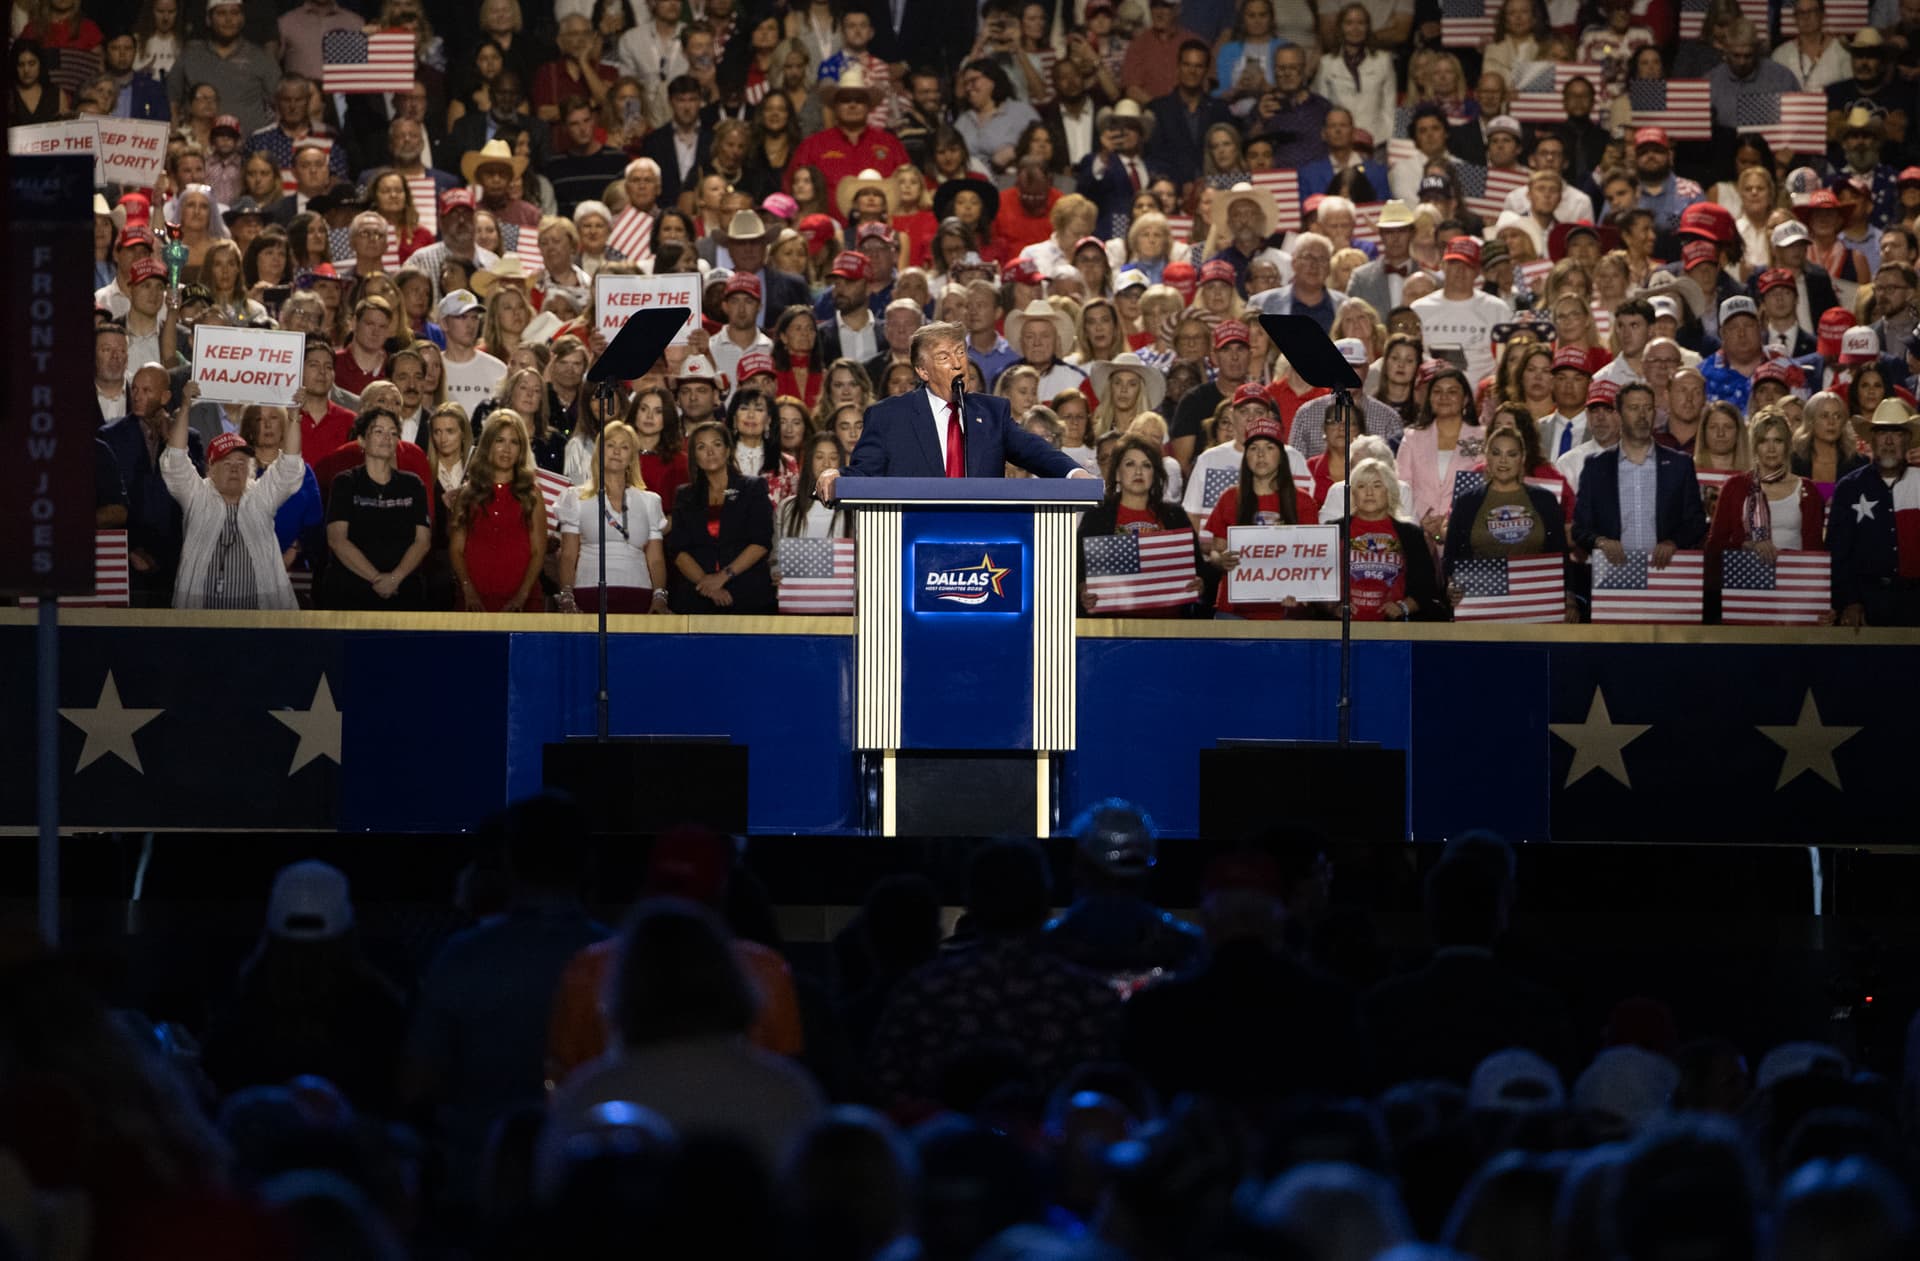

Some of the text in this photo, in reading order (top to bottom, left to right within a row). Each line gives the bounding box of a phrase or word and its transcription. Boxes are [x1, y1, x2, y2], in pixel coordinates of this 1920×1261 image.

[64, 136, 93, 150] THE
[101, 132, 159, 150] EEP THE
[104, 153, 159, 170] JORITY
[607, 291, 690, 306] KEEP THE
[30, 246, 54, 374] FRONT
[205, 345, 294, 363] KEEP THE
[200, 367, 296, 387] MAJORITY
[27, 384, 57, 460] ROW
[31, 471, 54, 574] JOES
[1240, 543, 1328, 559] KEEP THE
[927, 572, 989, 586] DALLAS
[1235, 566, 1333, 582] MAJORITY
